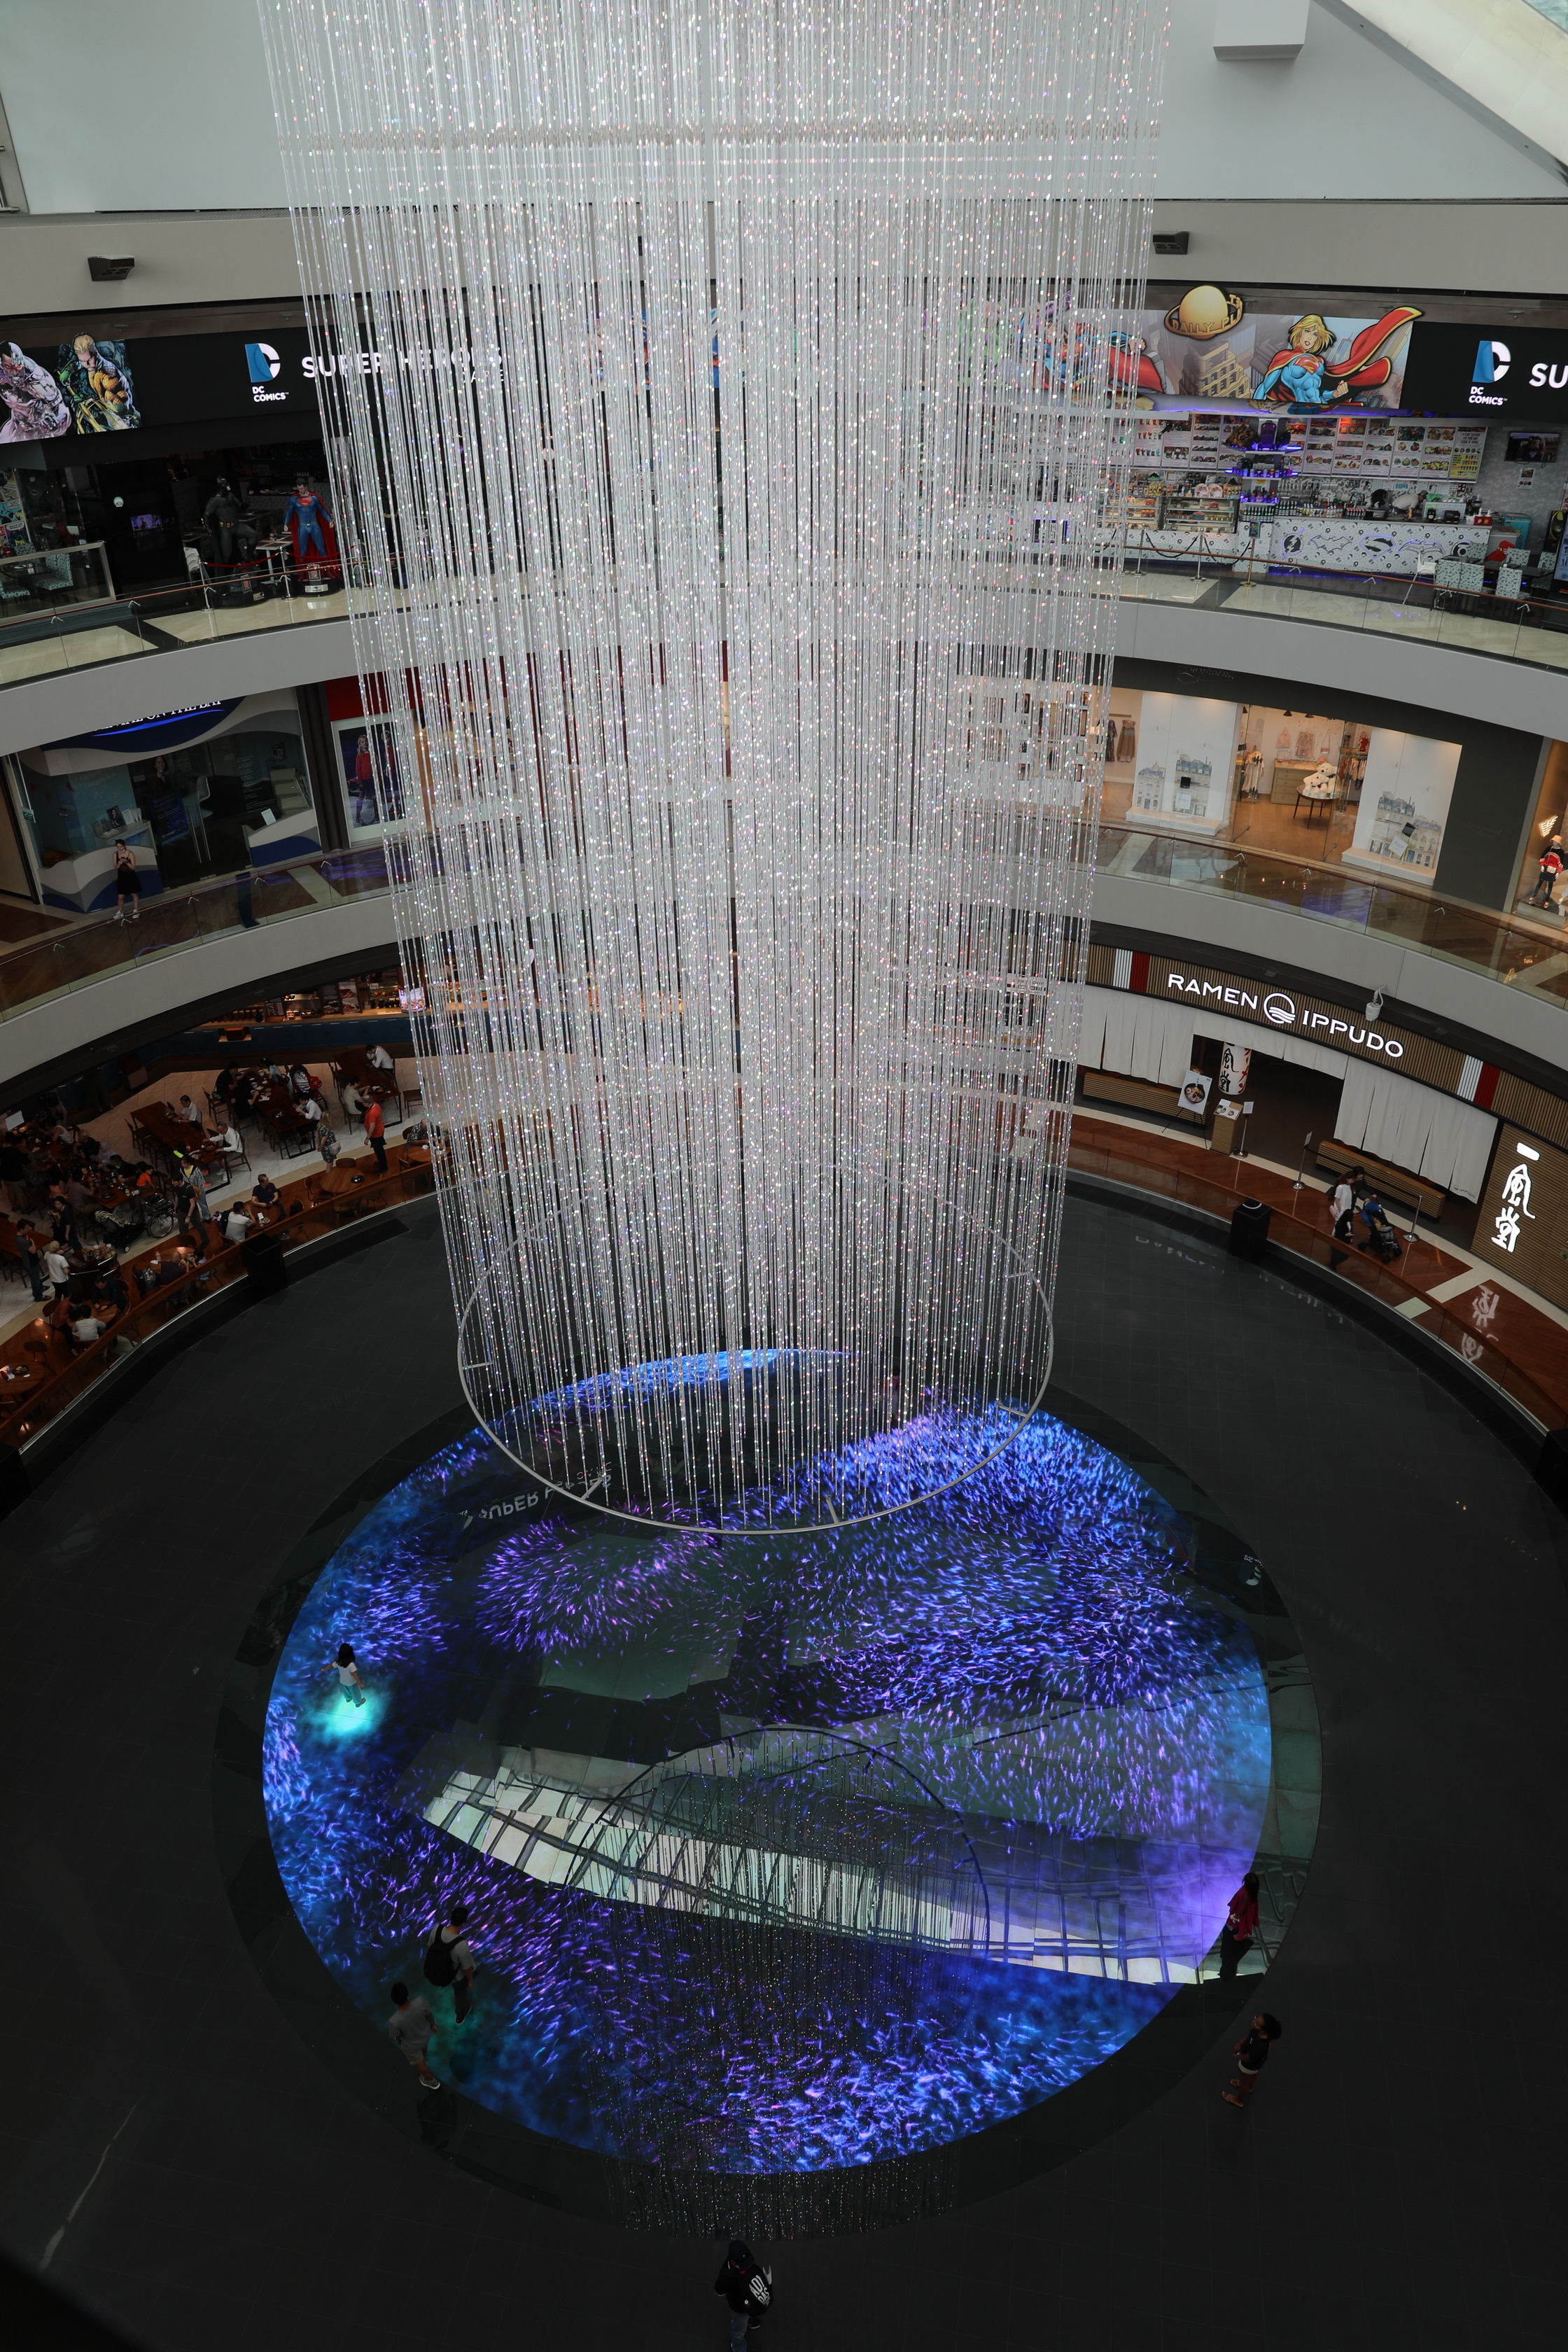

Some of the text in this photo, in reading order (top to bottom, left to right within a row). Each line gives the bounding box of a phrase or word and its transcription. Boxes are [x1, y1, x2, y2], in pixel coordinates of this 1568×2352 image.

[1172, 318, 1215, 334] DAILY
[252, 386, 265, 394] DC
[1470, 386, 1485, 395] DC
[1168, 973, 1404, 1058] RAMEN IPPUDO
[1490, 1142, 1540, 1253] 一風堂
